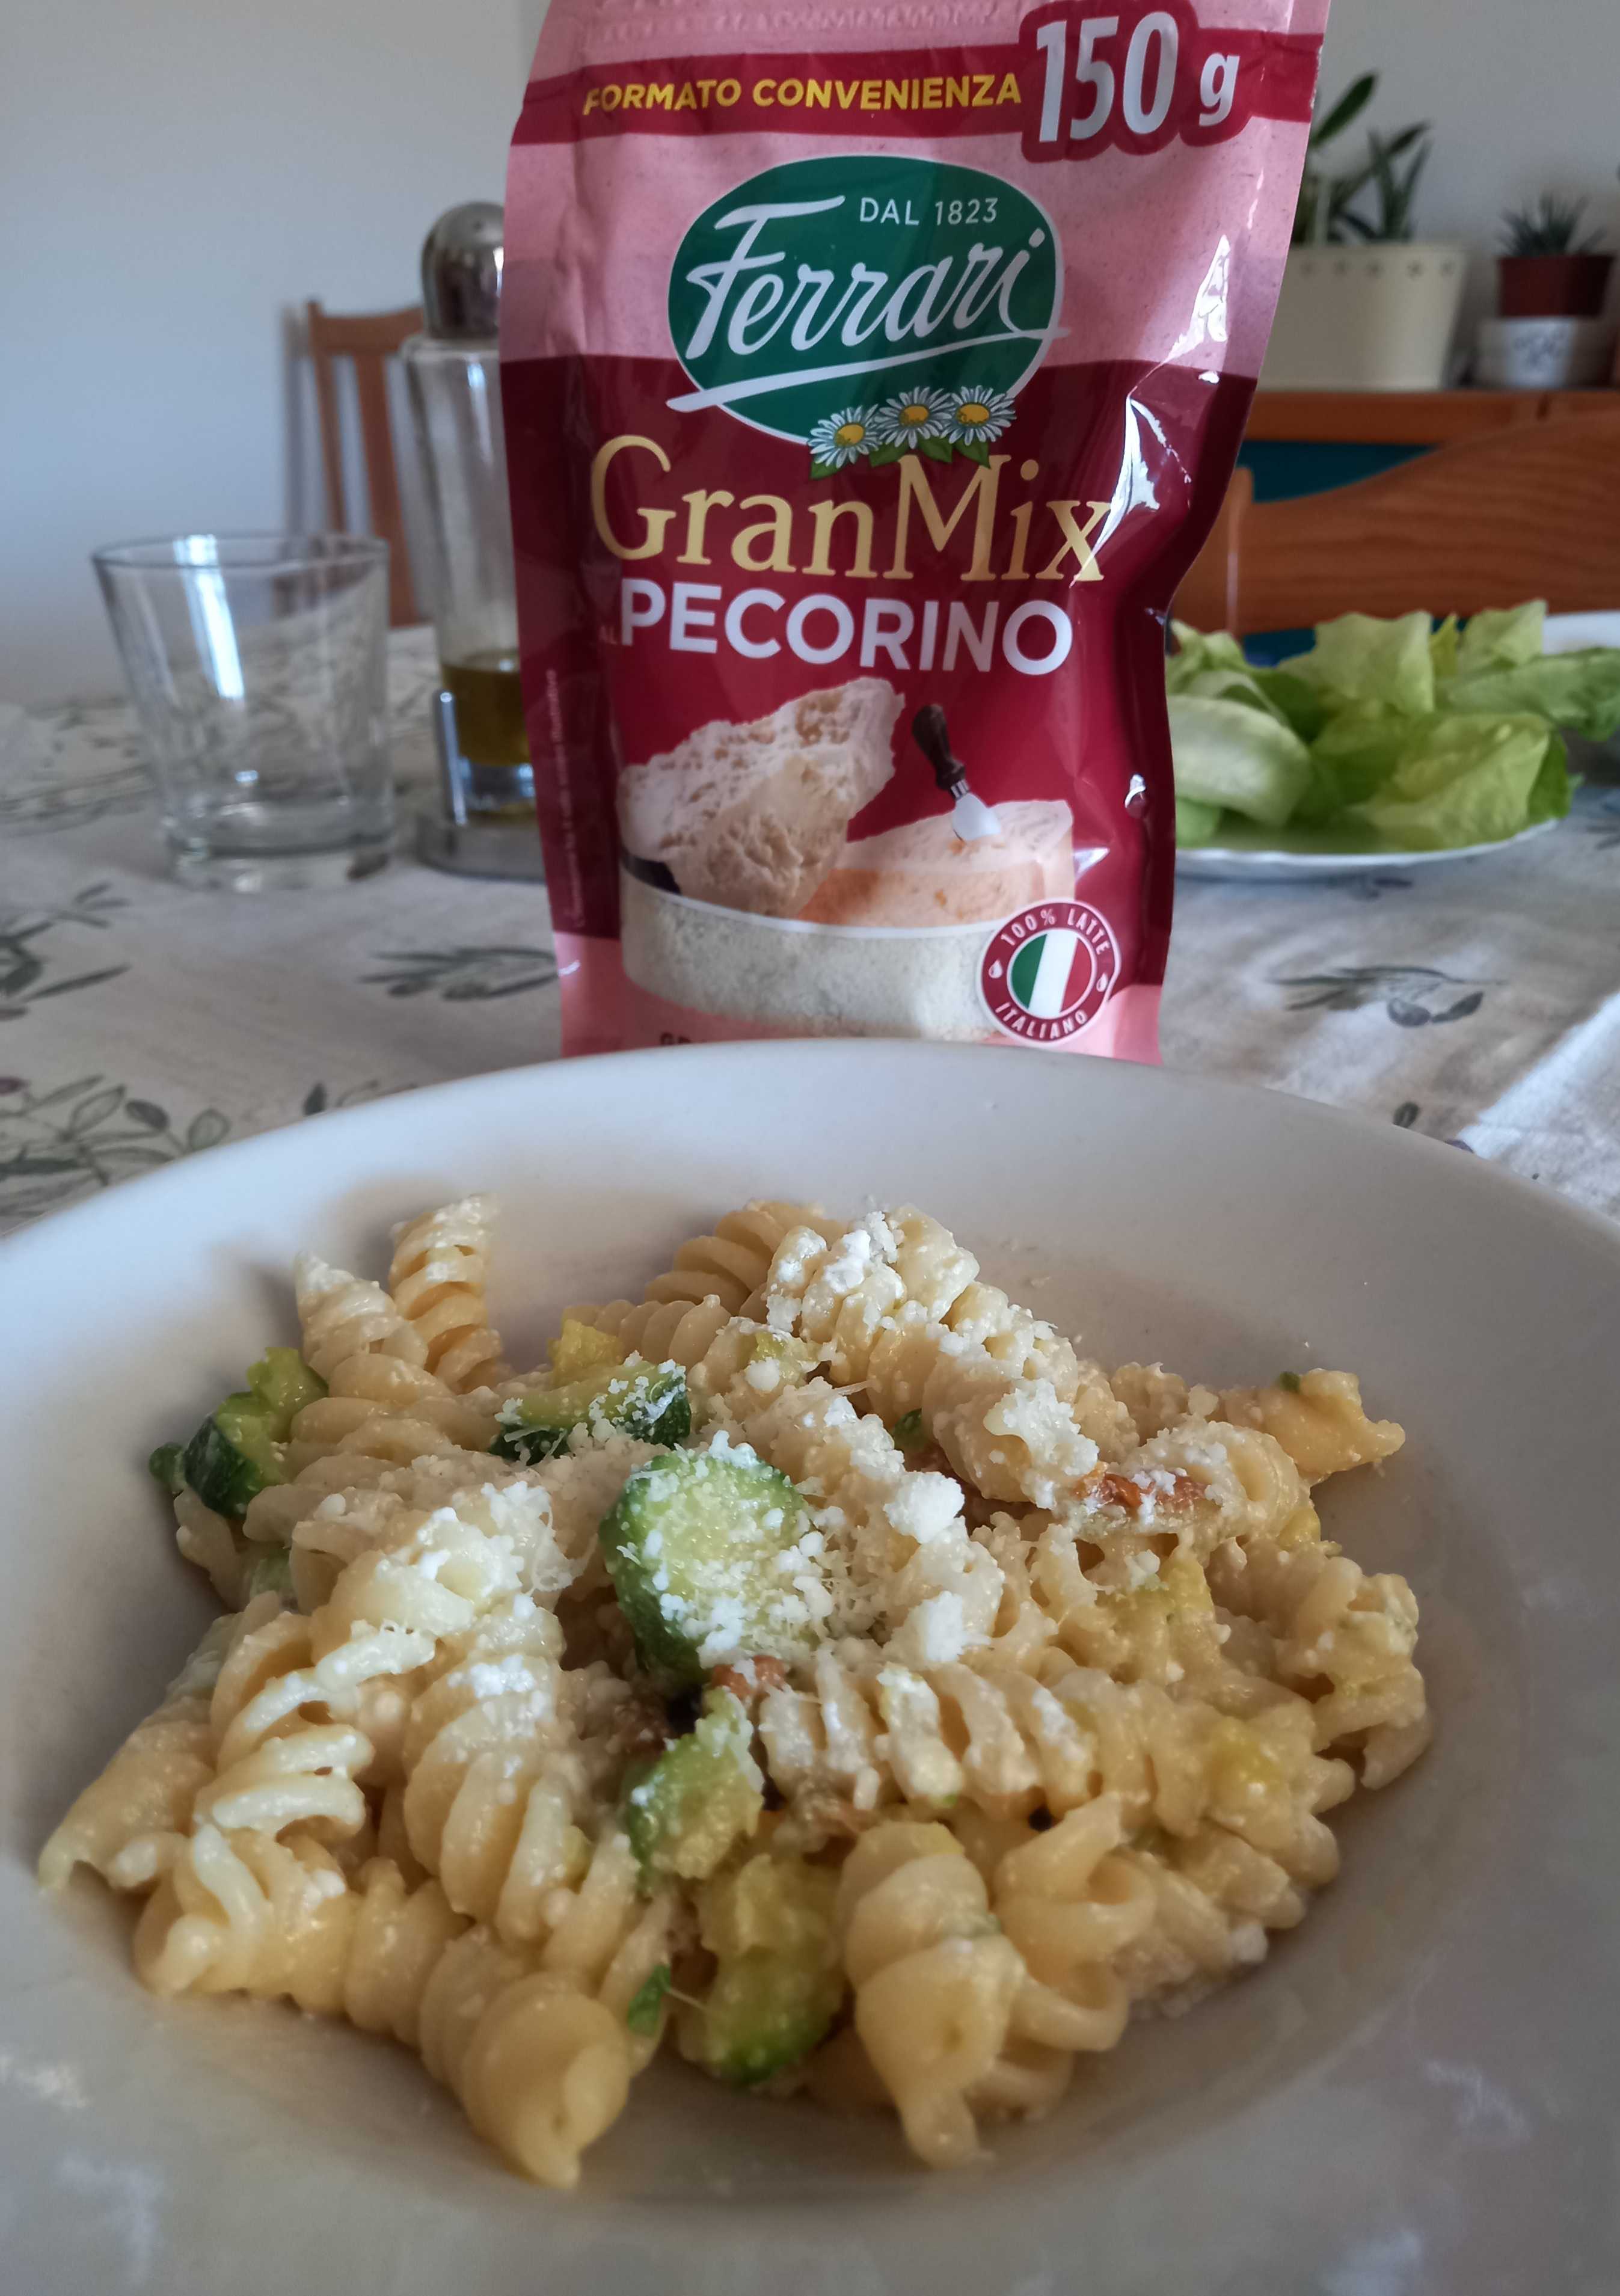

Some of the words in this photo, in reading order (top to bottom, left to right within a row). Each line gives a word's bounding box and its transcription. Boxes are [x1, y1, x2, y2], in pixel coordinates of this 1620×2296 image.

[583, 79, 741, 116] FORMATO
[753, 73, 1022, 110] CONVENIENZA
[1036, 12, 1179, 142] 150
[1197, 52, 1241, 126] g
[859, 197, 919, 227] DAL
[934, 197, 999, 224] 1823
[684, 195, 1070, 361] Ferrari
[621, 577, 1074, 676] PECORINO
[999, 907, 1056, 946] 100%
[1067, 908, 1111, 956] LATTE
[995, 1001, 1088, 1040] ITALIANO
